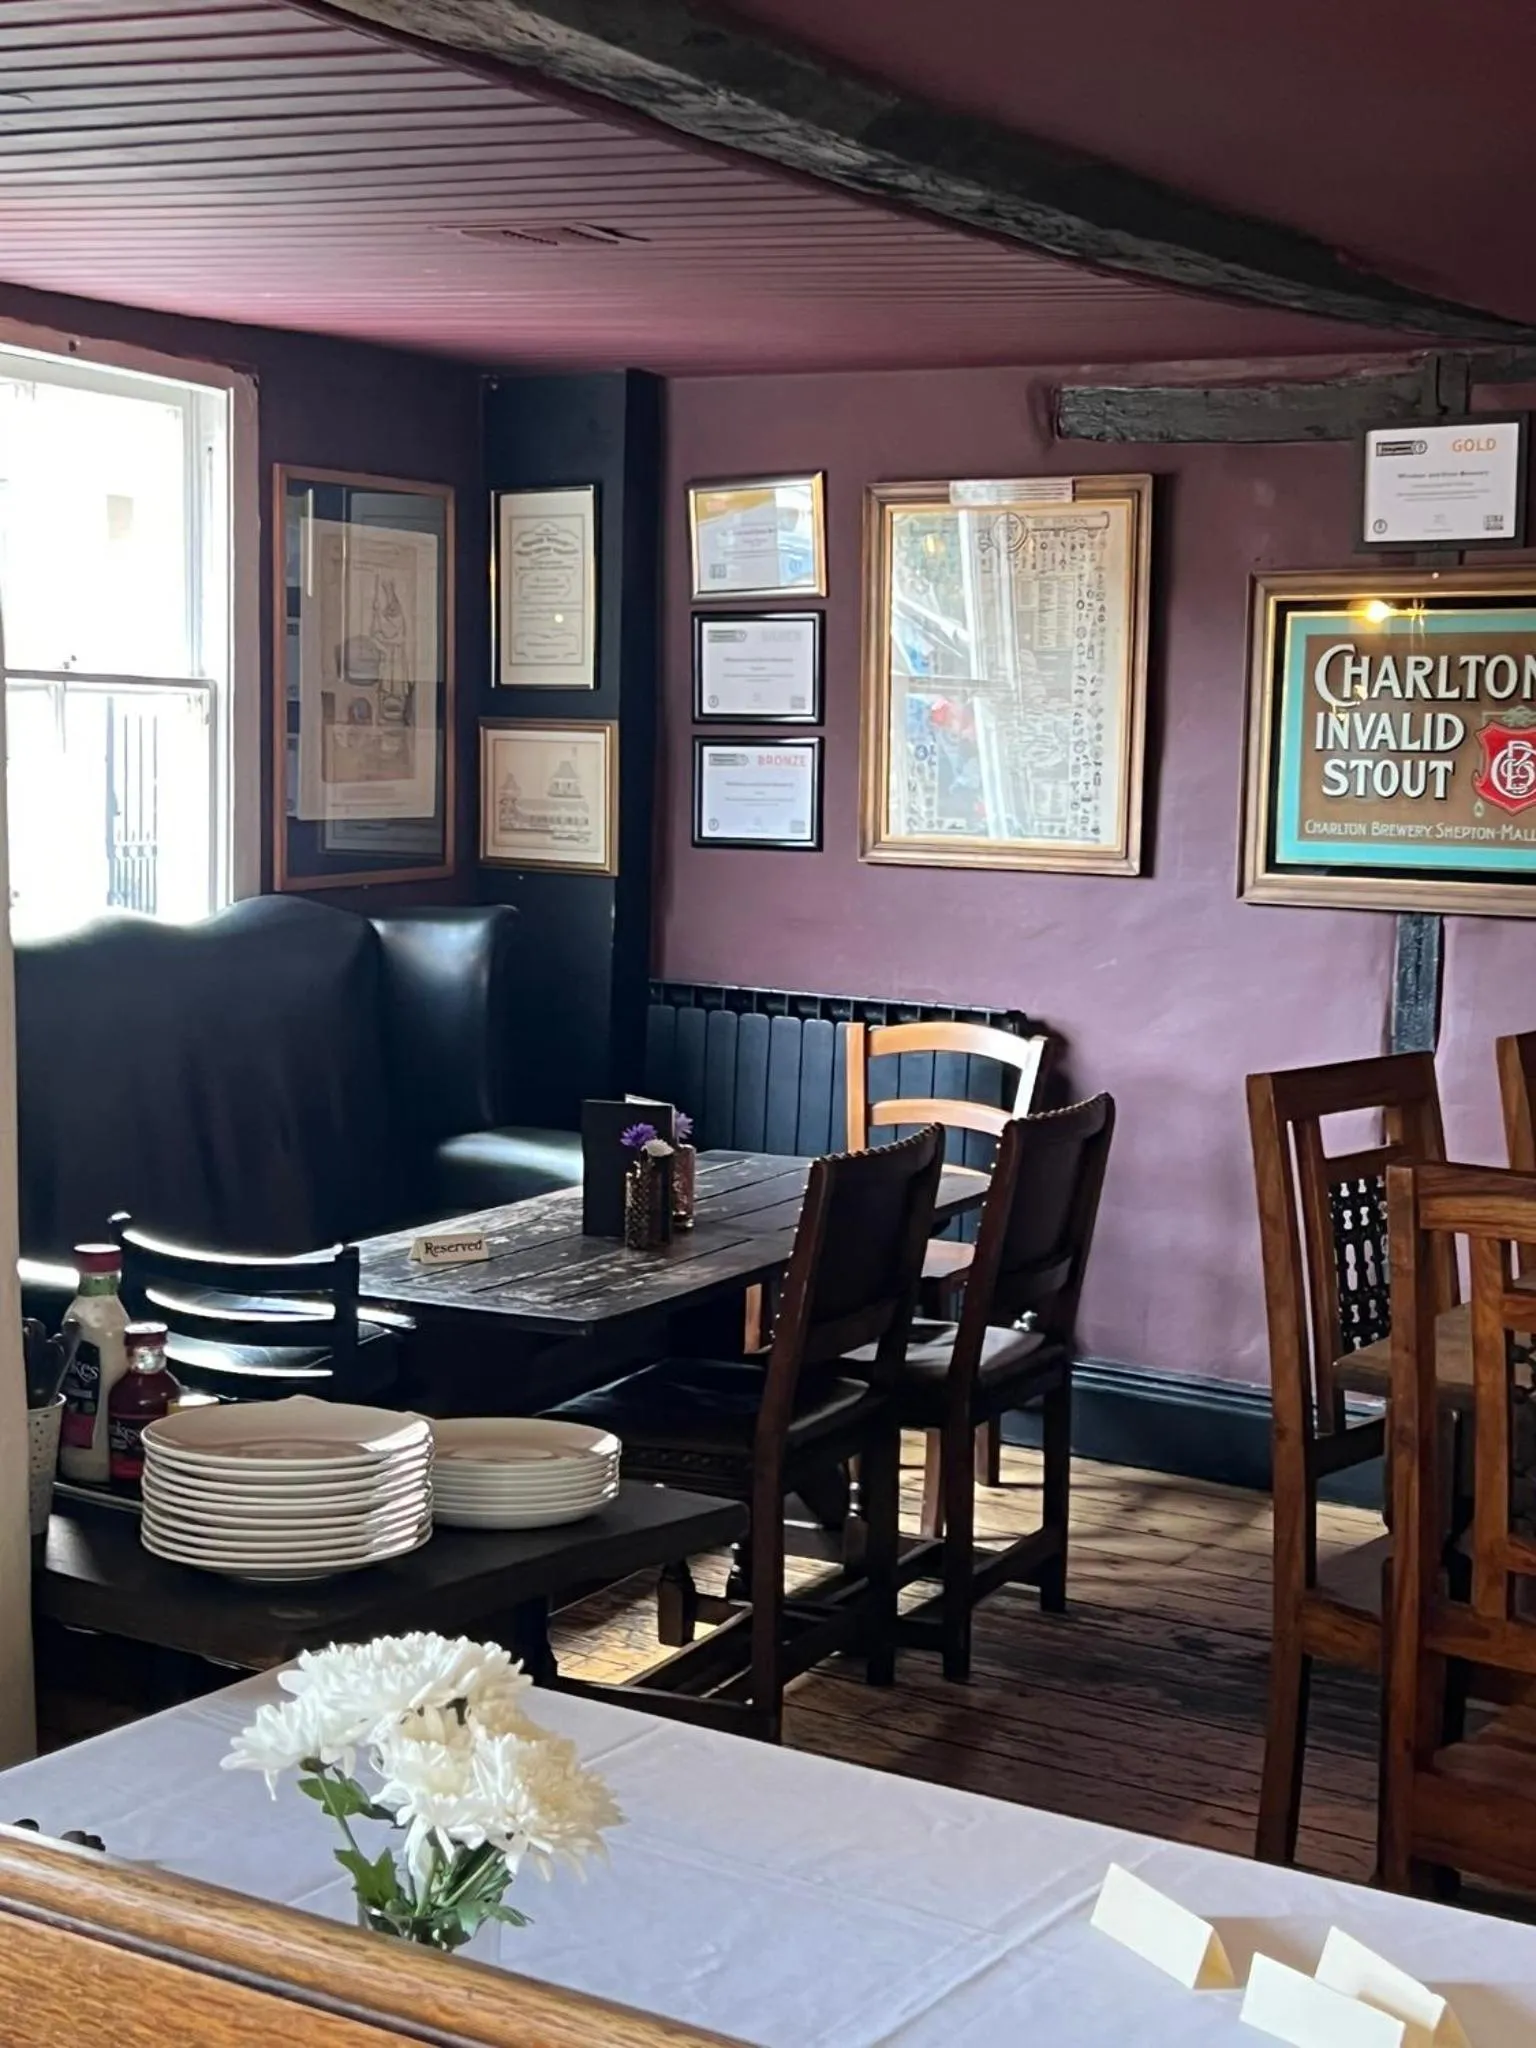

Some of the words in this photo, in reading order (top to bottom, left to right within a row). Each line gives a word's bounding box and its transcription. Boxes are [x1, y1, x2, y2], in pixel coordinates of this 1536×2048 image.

[1451, 437, 1497, 453] GOLD
[1314, 712, 1465, 751] INVALID
[757, 754, 807, 768] BRONZE
[1321, 758, 1454, 799] STOUT
[1304, 819, 1367, 836] CHARLTON
[424, 1239, 483, 1257] Reserved
